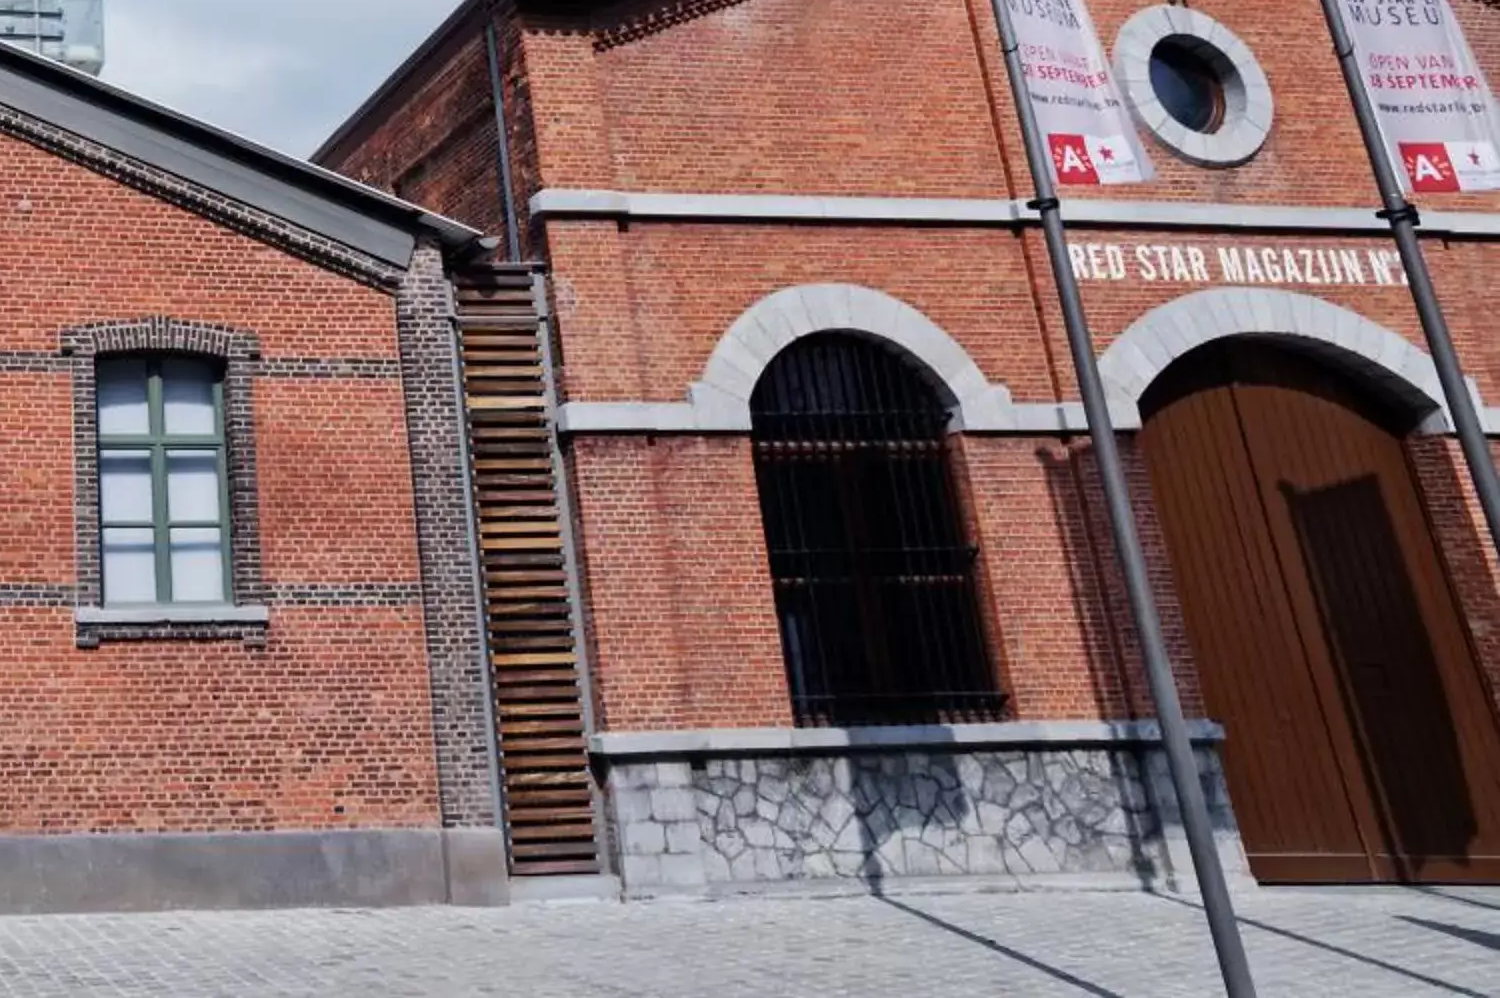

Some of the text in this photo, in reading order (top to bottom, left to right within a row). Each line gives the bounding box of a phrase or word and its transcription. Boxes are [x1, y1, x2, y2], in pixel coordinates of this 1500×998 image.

[1066, 243, 1127, 281] RED
[1134, 245, 1211, 283] STAR
[1218, 247, 1366, 285] MAGAZIJN
